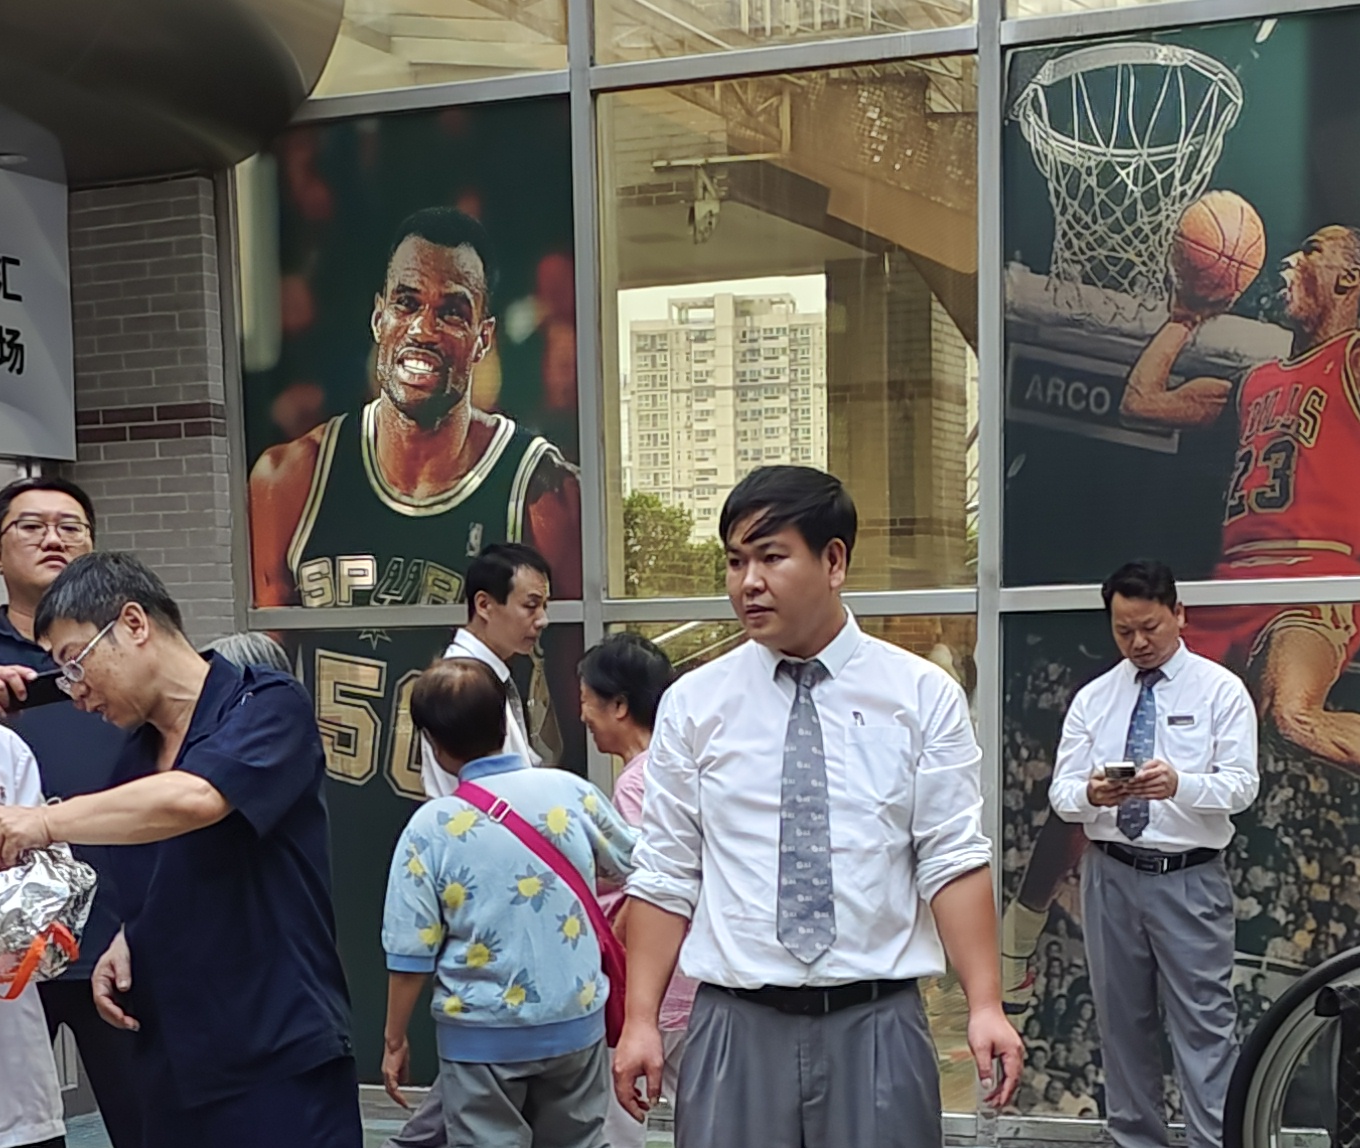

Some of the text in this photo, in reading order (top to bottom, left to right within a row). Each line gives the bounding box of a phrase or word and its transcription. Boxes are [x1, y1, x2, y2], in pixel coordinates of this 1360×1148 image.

[1025, 374, 1111, 416] ARCO
[1223, 436, 1298, 526] 23
[299, 554, 467, 608] SPUR
